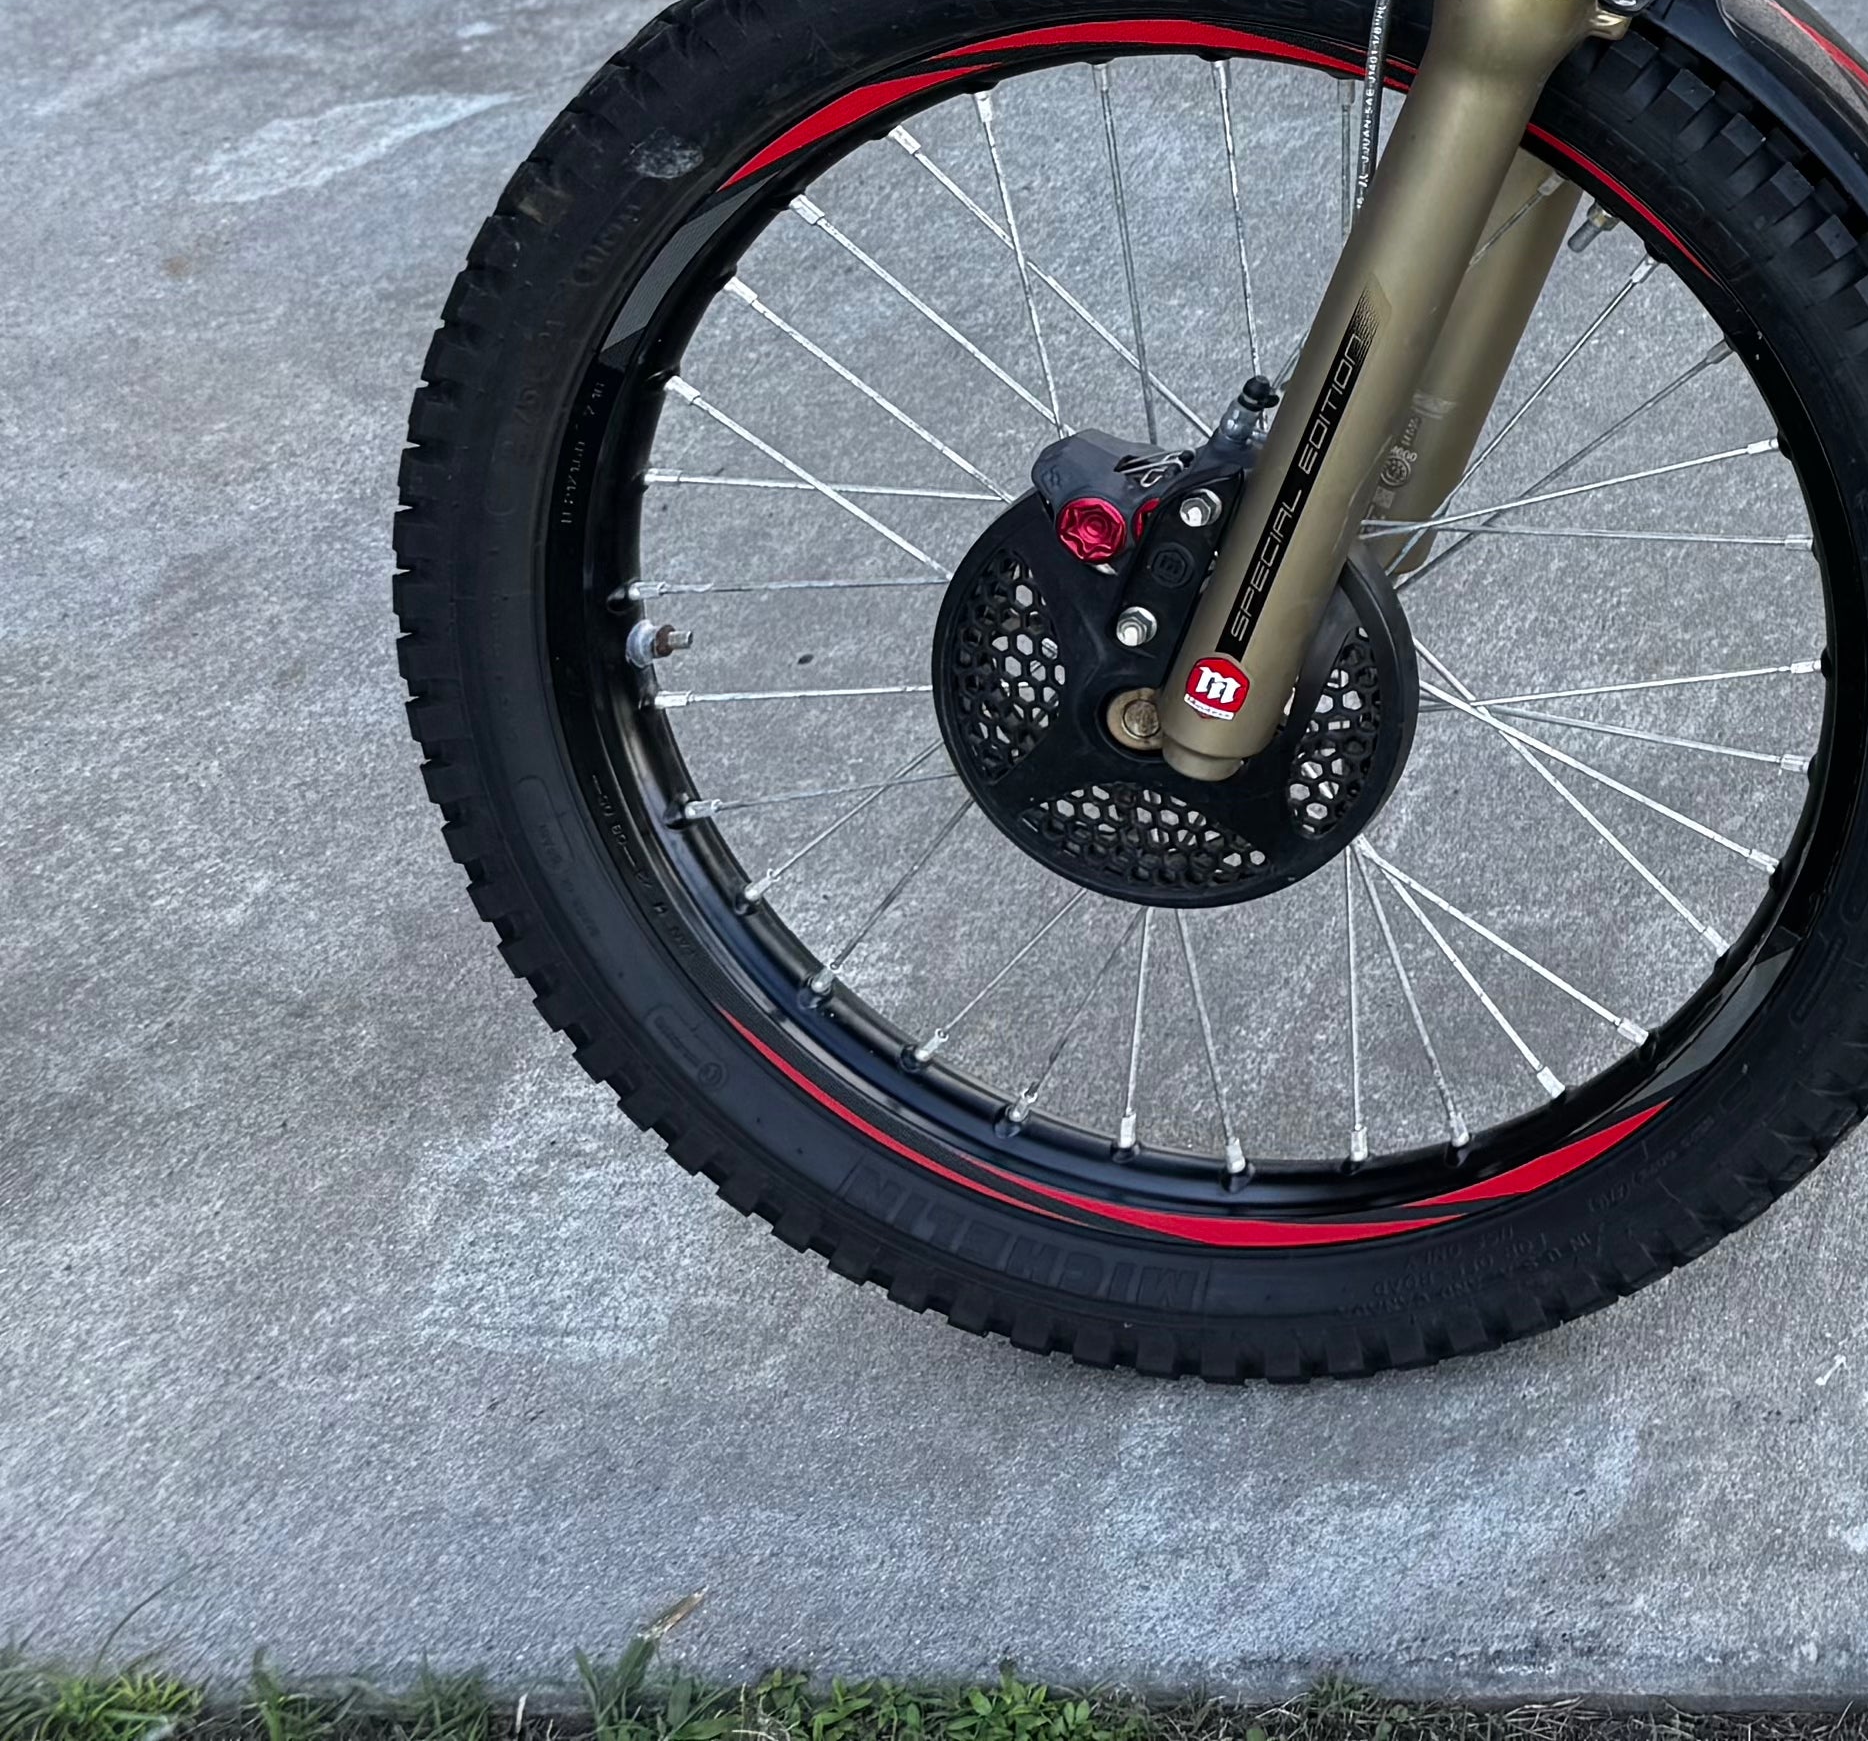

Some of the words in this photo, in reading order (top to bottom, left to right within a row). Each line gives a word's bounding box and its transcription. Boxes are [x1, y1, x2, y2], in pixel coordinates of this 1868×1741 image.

[1230, 489, 1303, 643] SPECIAL
[1298, 335, 1362, 476] EDITION
[843, 1164, 1200, 1308] MICHELIN
